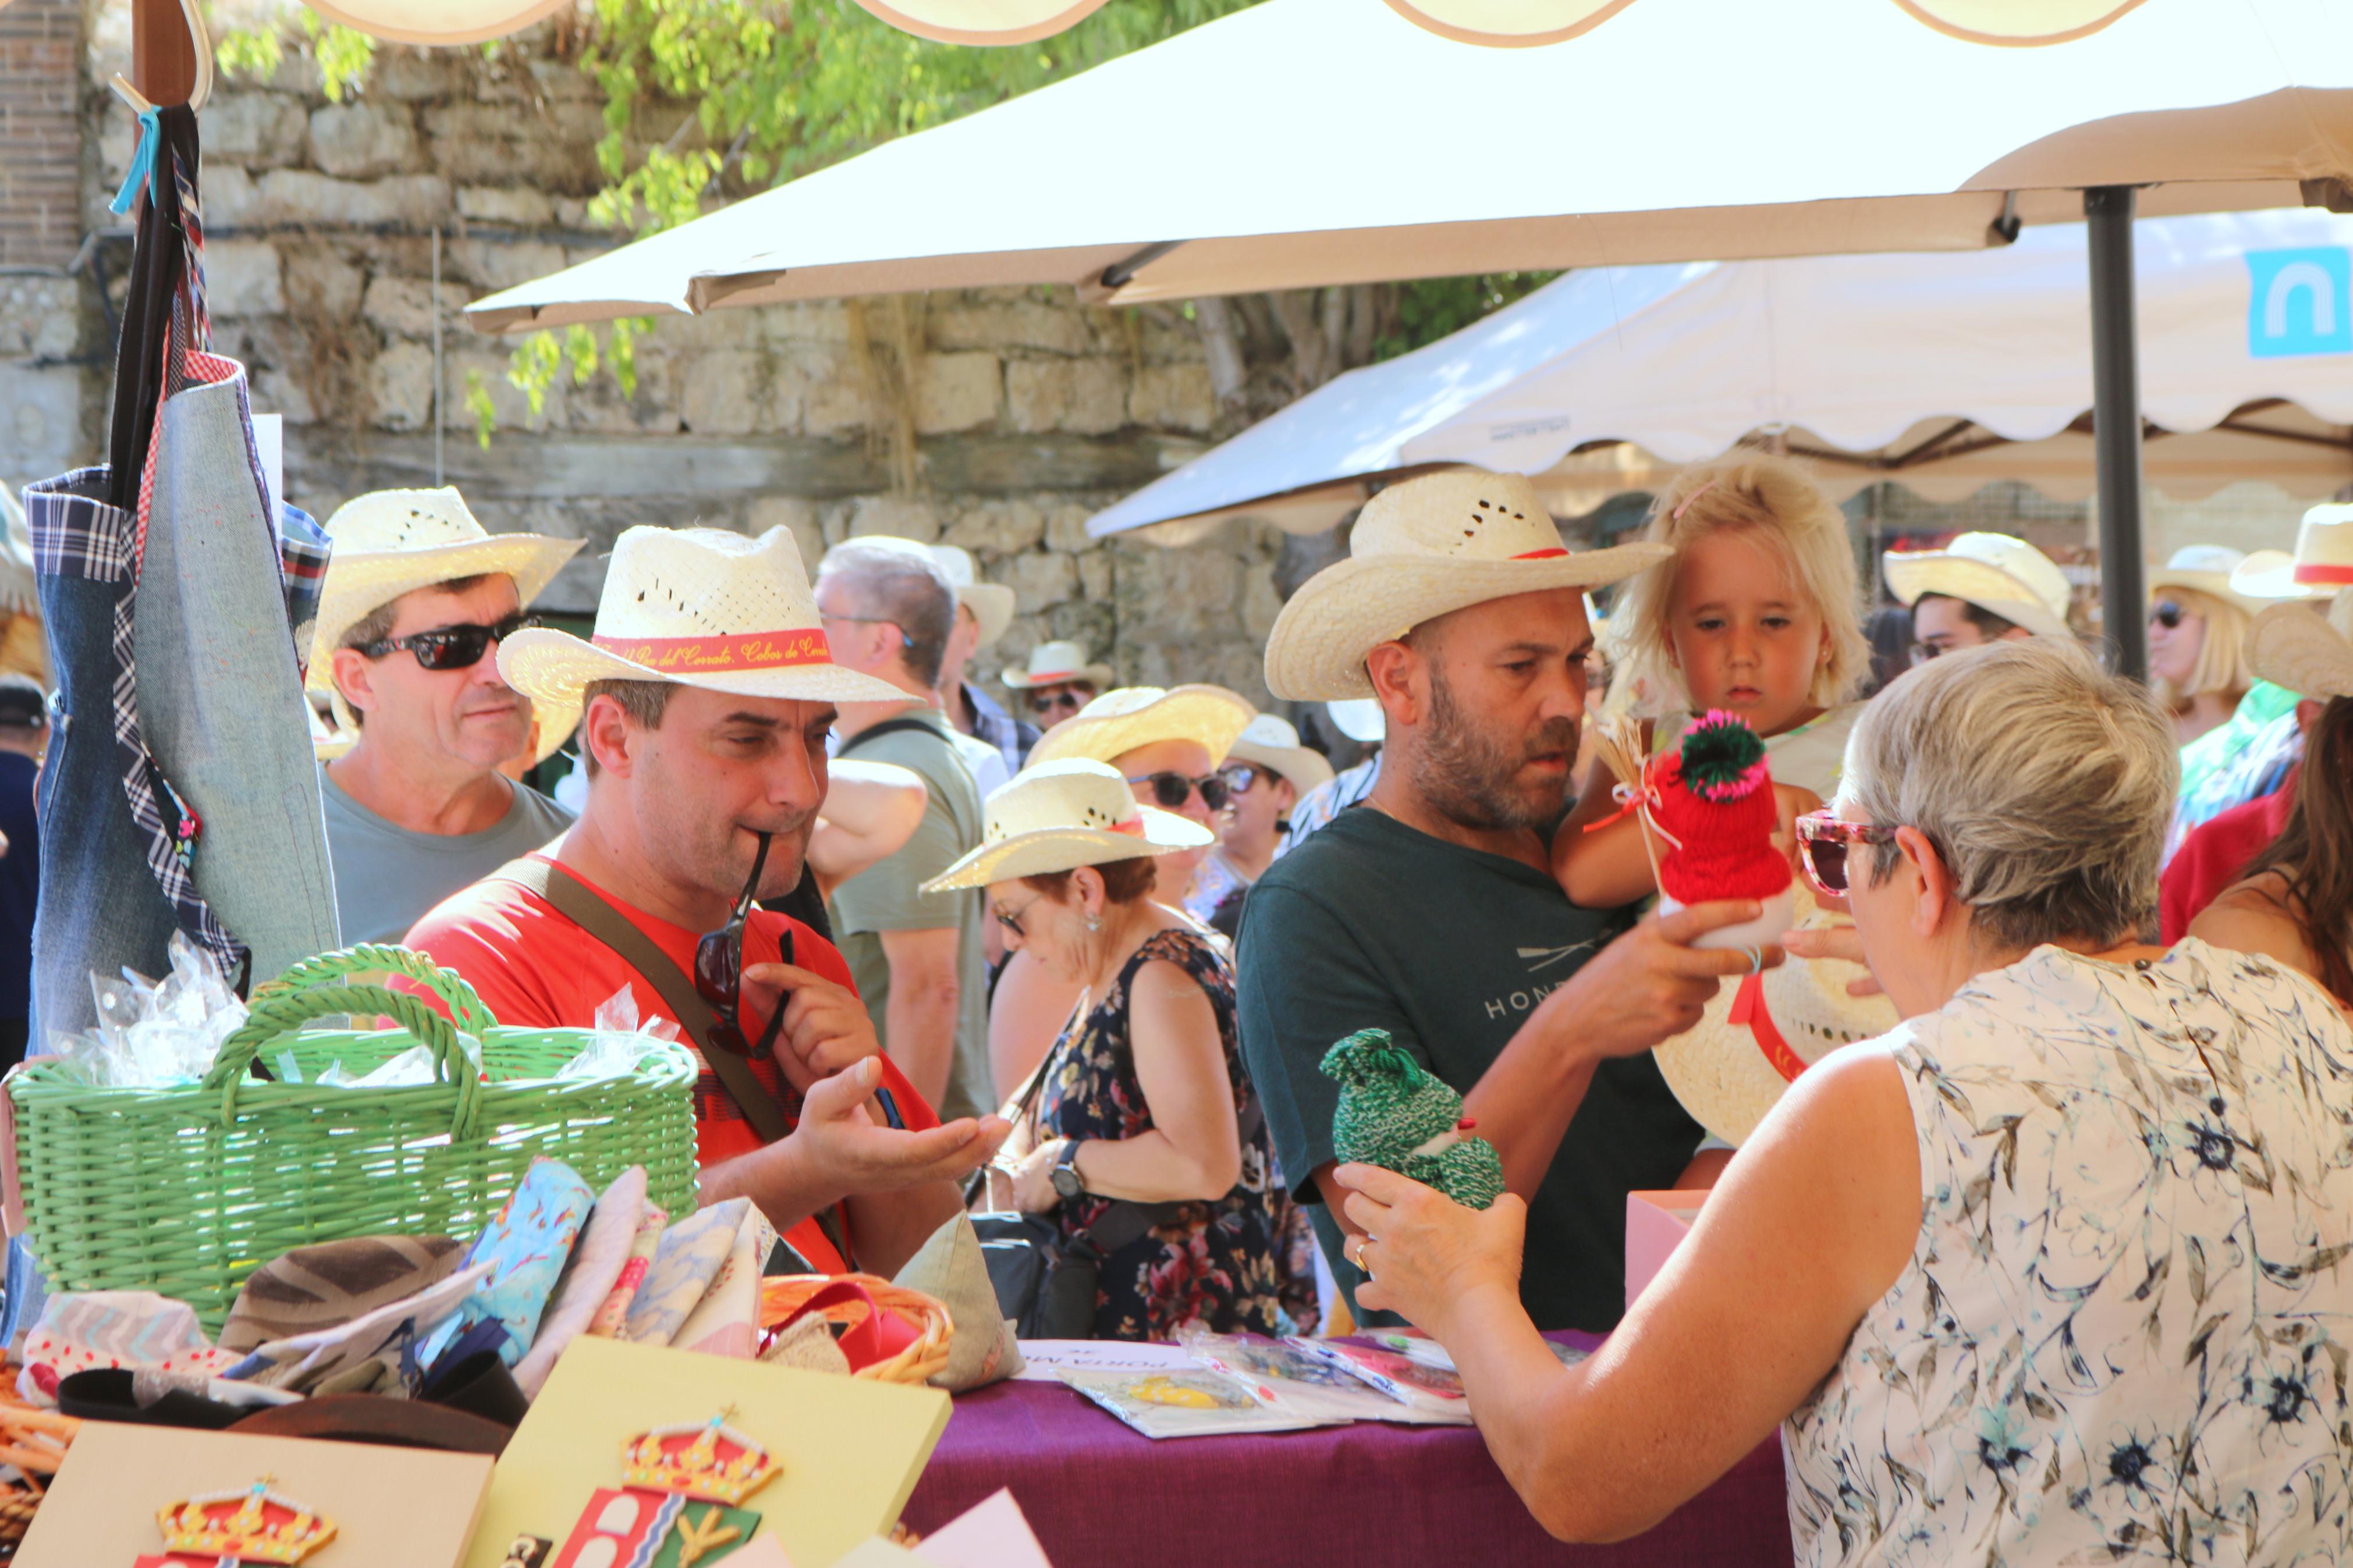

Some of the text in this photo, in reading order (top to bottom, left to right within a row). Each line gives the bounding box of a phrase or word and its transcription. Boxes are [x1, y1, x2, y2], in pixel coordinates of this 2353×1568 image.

[659, 647, 682, 666] del
[740, 641, 783, 662] Cobos
[785, 639, 798, 659] de
[1484, 981, 1566, 1019] HON
